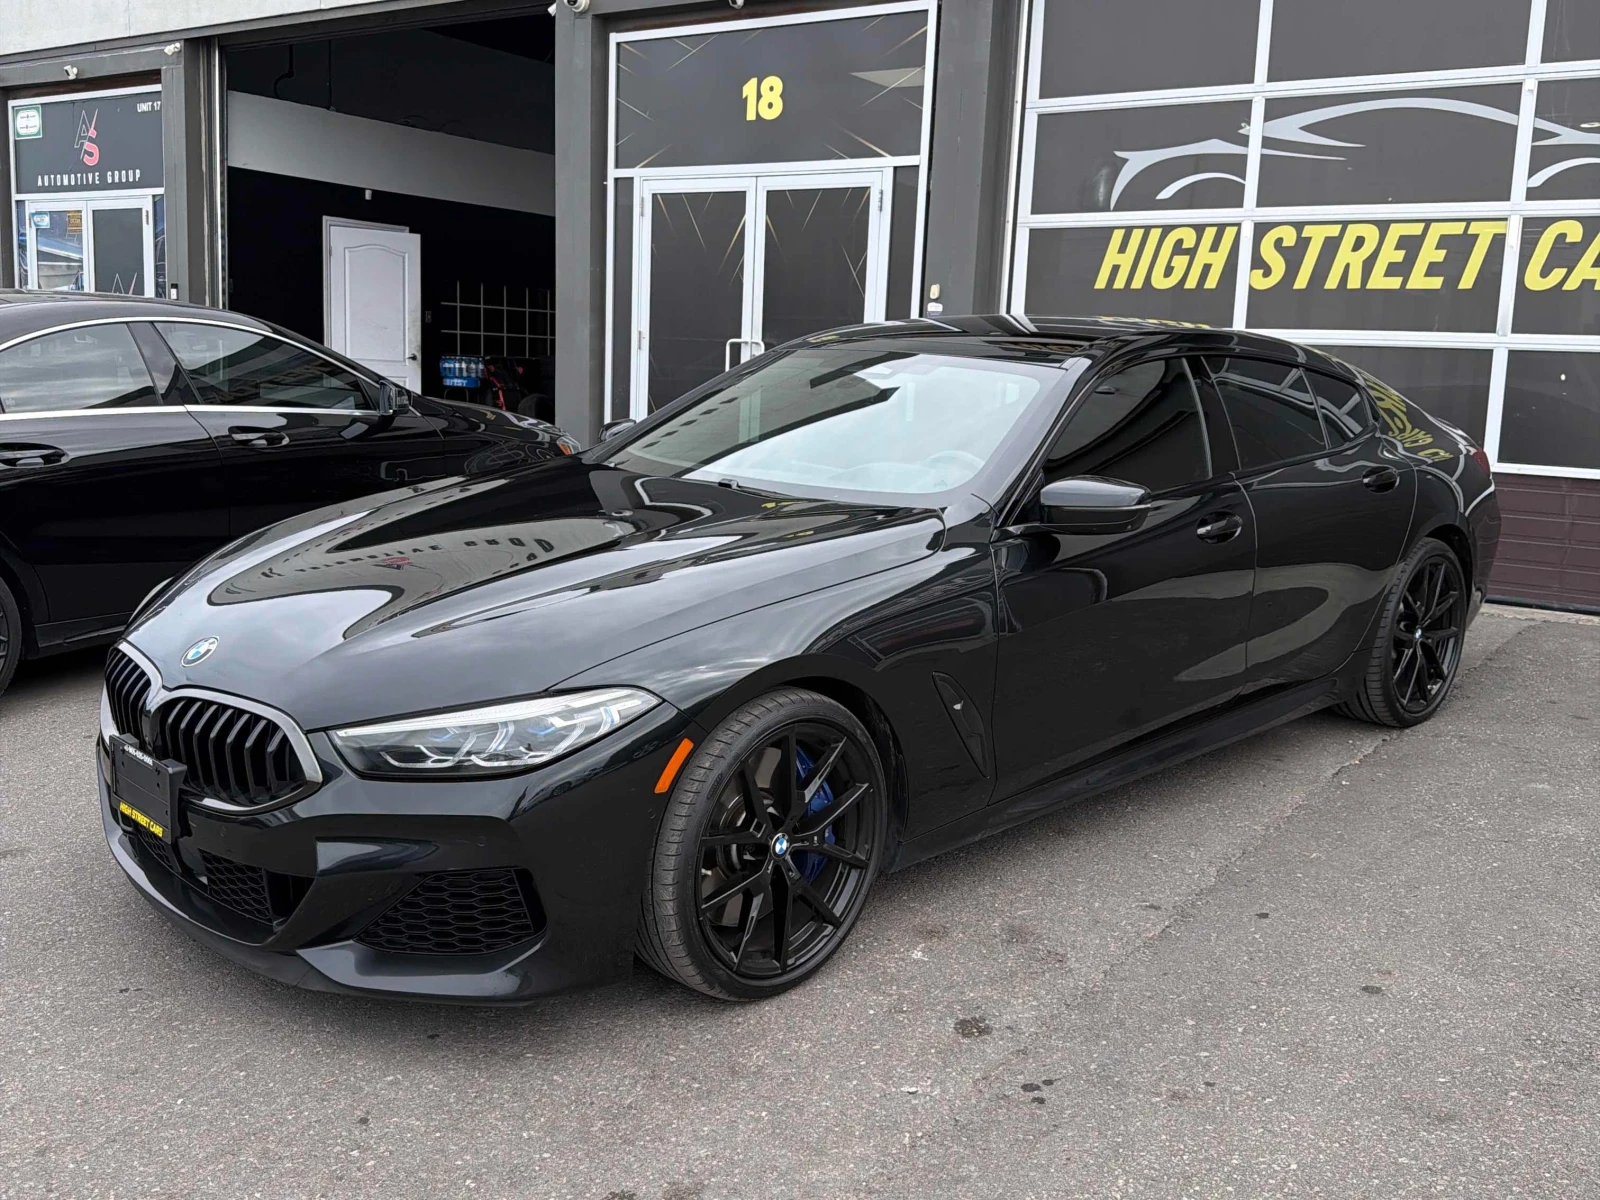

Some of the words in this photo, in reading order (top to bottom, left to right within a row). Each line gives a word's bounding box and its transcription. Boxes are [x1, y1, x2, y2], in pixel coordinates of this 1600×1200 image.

[136, 101, 153, 113] UNIT
[153, 100, 162, 111] 17
[742, 75, 784, 121] 18
[37, 172, 100, 187] AUTOMOTIVE
[107, 169, 141, 184] GROUP
[1093, 226, 1239, 290] HIGH
[1249, 221, 1508, 291] STREET
